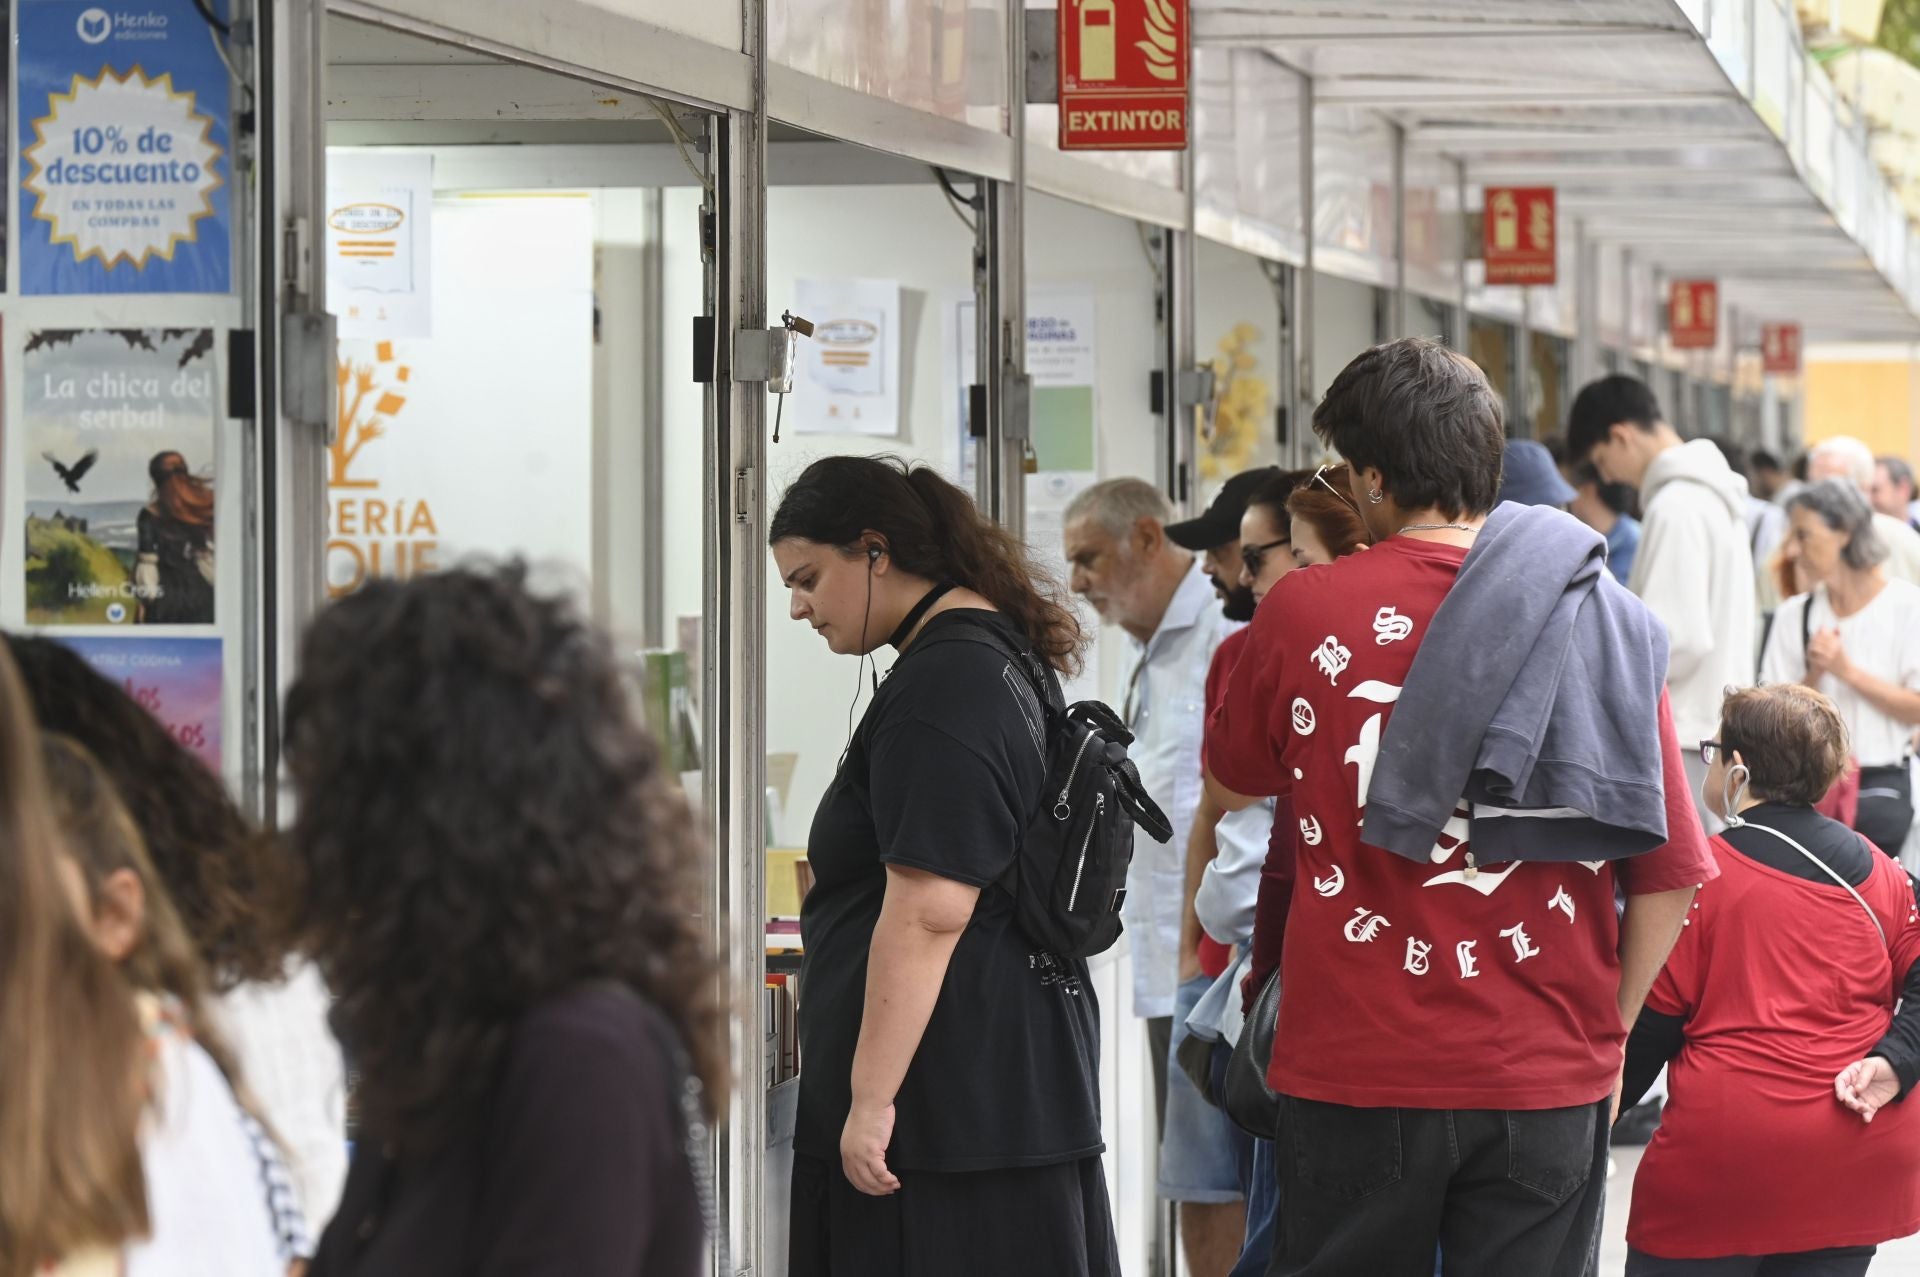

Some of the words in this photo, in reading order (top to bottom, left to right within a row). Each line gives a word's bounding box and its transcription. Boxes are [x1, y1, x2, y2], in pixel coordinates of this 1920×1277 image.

[114, 11, 168, 28] Henko
[114, 29, 168, 41] ediciones
[1069, 109, 1181, 131] EXTINTOR
[73, 125, 128, 155] 10%
[137, 126, 173, 153] de
[46, 156, 200, 185] descuento
[72, 200, 90, 211] EN
[95, 199, 144, 211] TODAS
[149, 199, 176, 211] LAS
[88, 215, 160, 228] COMPRAS
[44, 373, 75, 399] La
[86, 371, 159, 399] chica
[170, 370, 211, 399] del
[79, 402, 165, 430] serbal
[337, 497, 438, 536] ERÍA
[90, 652, 127, 667] ATRIZ
